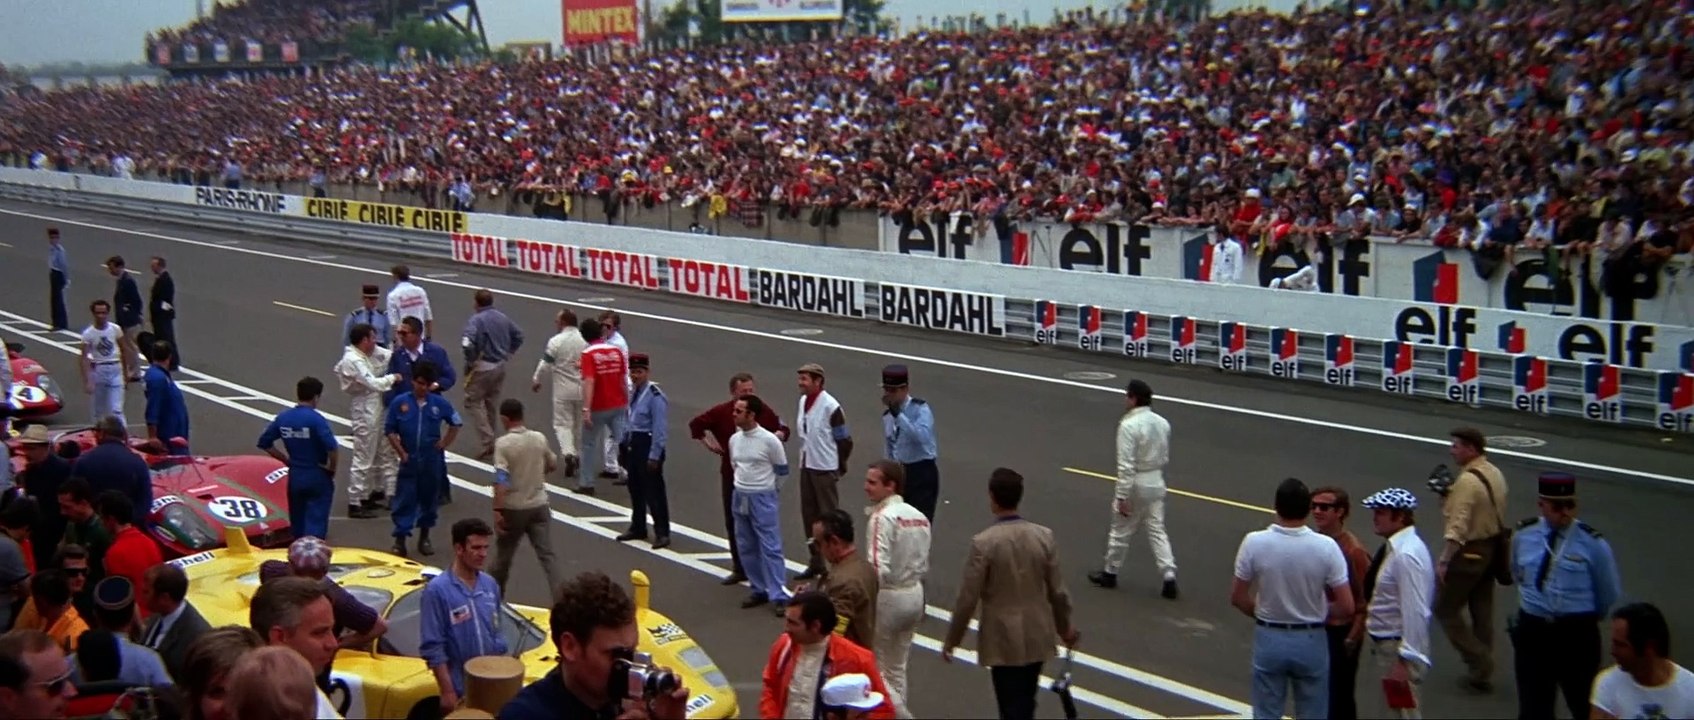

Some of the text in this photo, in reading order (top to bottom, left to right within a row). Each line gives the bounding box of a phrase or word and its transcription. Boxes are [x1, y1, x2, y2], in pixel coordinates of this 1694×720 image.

[567, 6, 635, 35] MINTEX
[898, 215, 973, 260] elf
[452, 233, 508, 267] TOTAL
[517, 240, 581, 277] TOTAL
[1059, 223, 1151, 276] elf
[587, 249, 658, 288] TOTAL
[1258, 238, 1370, 296] elf
[669, 259, 748, 301] TOTAL
[759, 270, 863, 317] BARDAHL
[881, 284, 1003, 336] BARDAHL
[1036, 329, 1055, 344] elf
[1396, 305, 1475, 348] elf
[1080, 335, 1100, 351] elf
[1125, 341, 1146, 357] elf
[1558, 323, 1654, 367] elf
[1173, 347, 1194, 363] elf
[1222, 354, 1244, 371] elf
[1272, 361, 1295, 379] elf
[1327, 368, 1352, 386] elf
[1384, 375, 1411, 393] elf
[1449, 384, 1476, 404] elf
[1515, 393, 1545, 414] elf
[1586, 401, 1618, 421] elf
[1660, 412, 1693, 432] elf
[280, 426, 310, 439] Shell
[219, 499, 261, 519] 38
